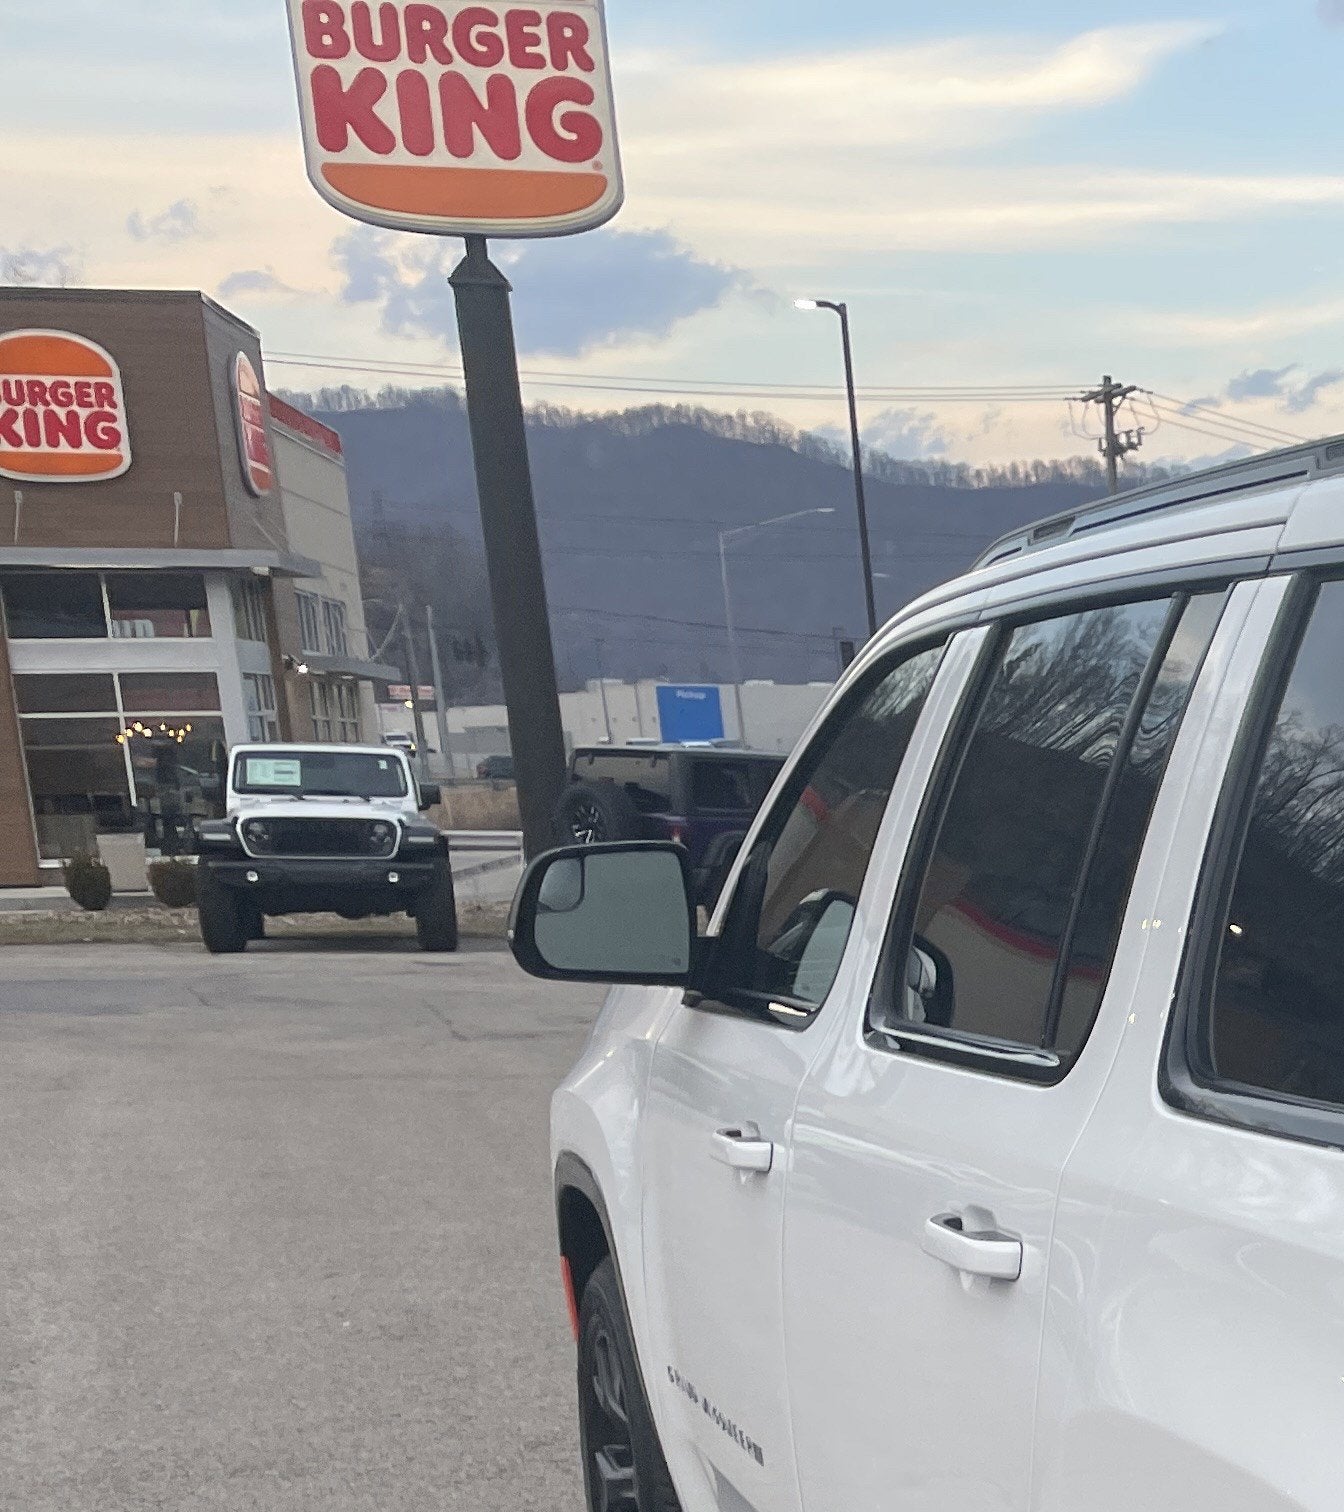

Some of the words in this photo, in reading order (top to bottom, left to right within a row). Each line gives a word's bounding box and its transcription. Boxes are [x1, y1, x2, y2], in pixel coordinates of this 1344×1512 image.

[302, 0, 595, 72] BURGER
[310, 64, 603, 163] KING
[0, 378, 118, 409] URGER
[0, 407, 122, 450] KING
